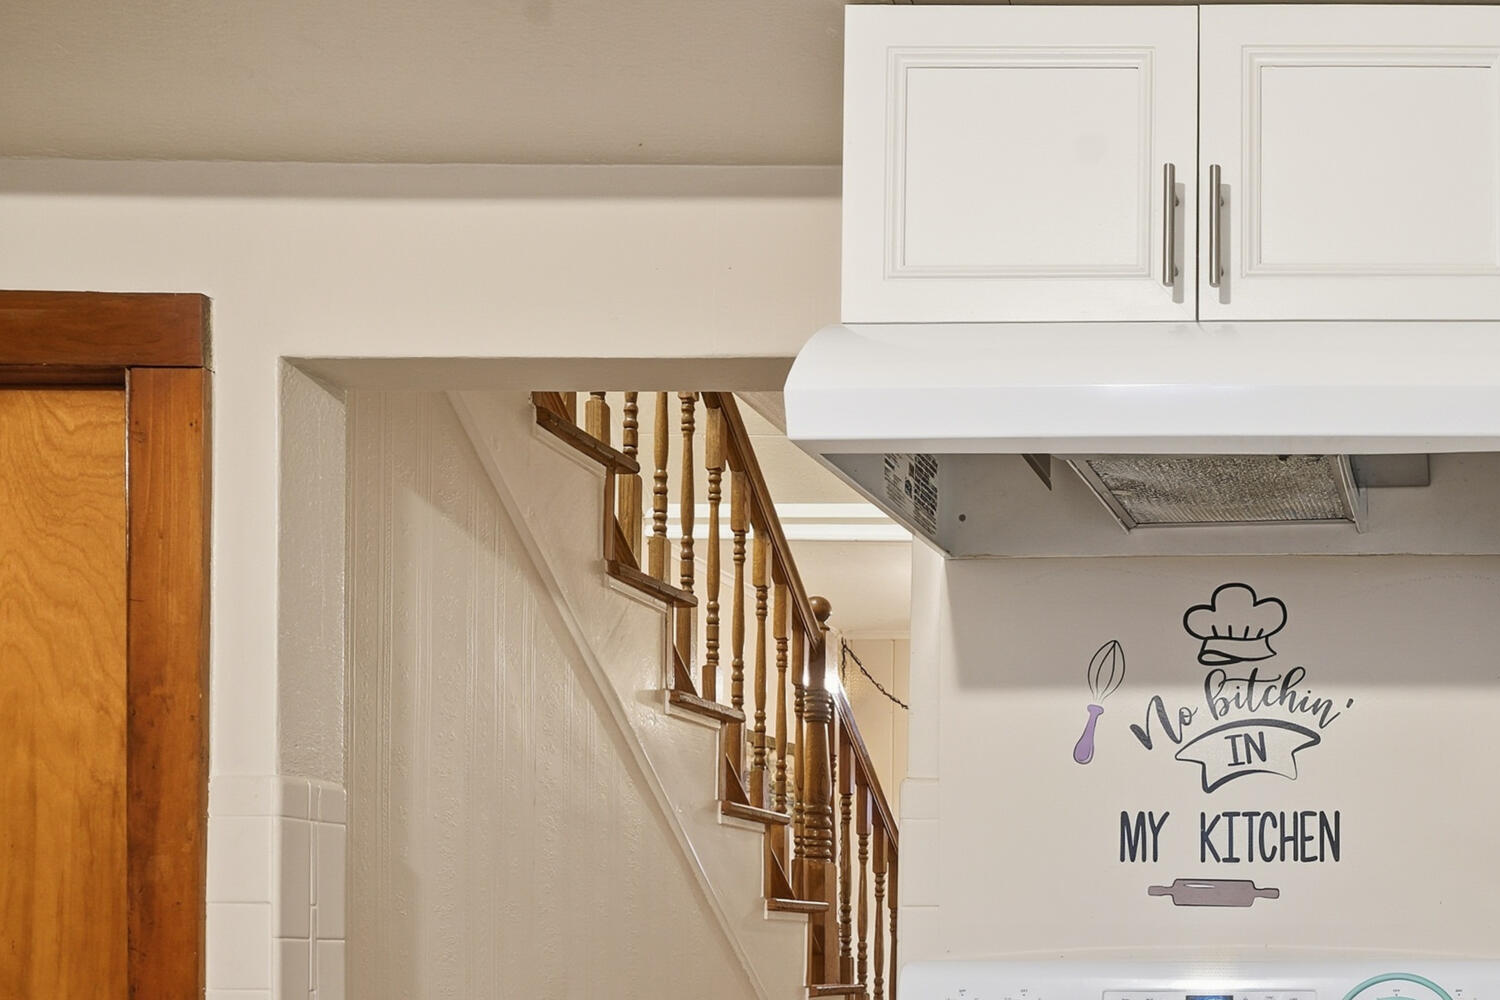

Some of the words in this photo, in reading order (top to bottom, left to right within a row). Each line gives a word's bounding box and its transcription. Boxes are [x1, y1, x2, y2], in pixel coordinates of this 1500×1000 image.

[1129, 695, 1198, 750] No
[1204, 666, 1354, 728] bitchin'
[1224, 731, 1267, 766] IN
[1119, 811, 1170, 863] MY
[1200, 811, 1340, 863] KITCHEN
